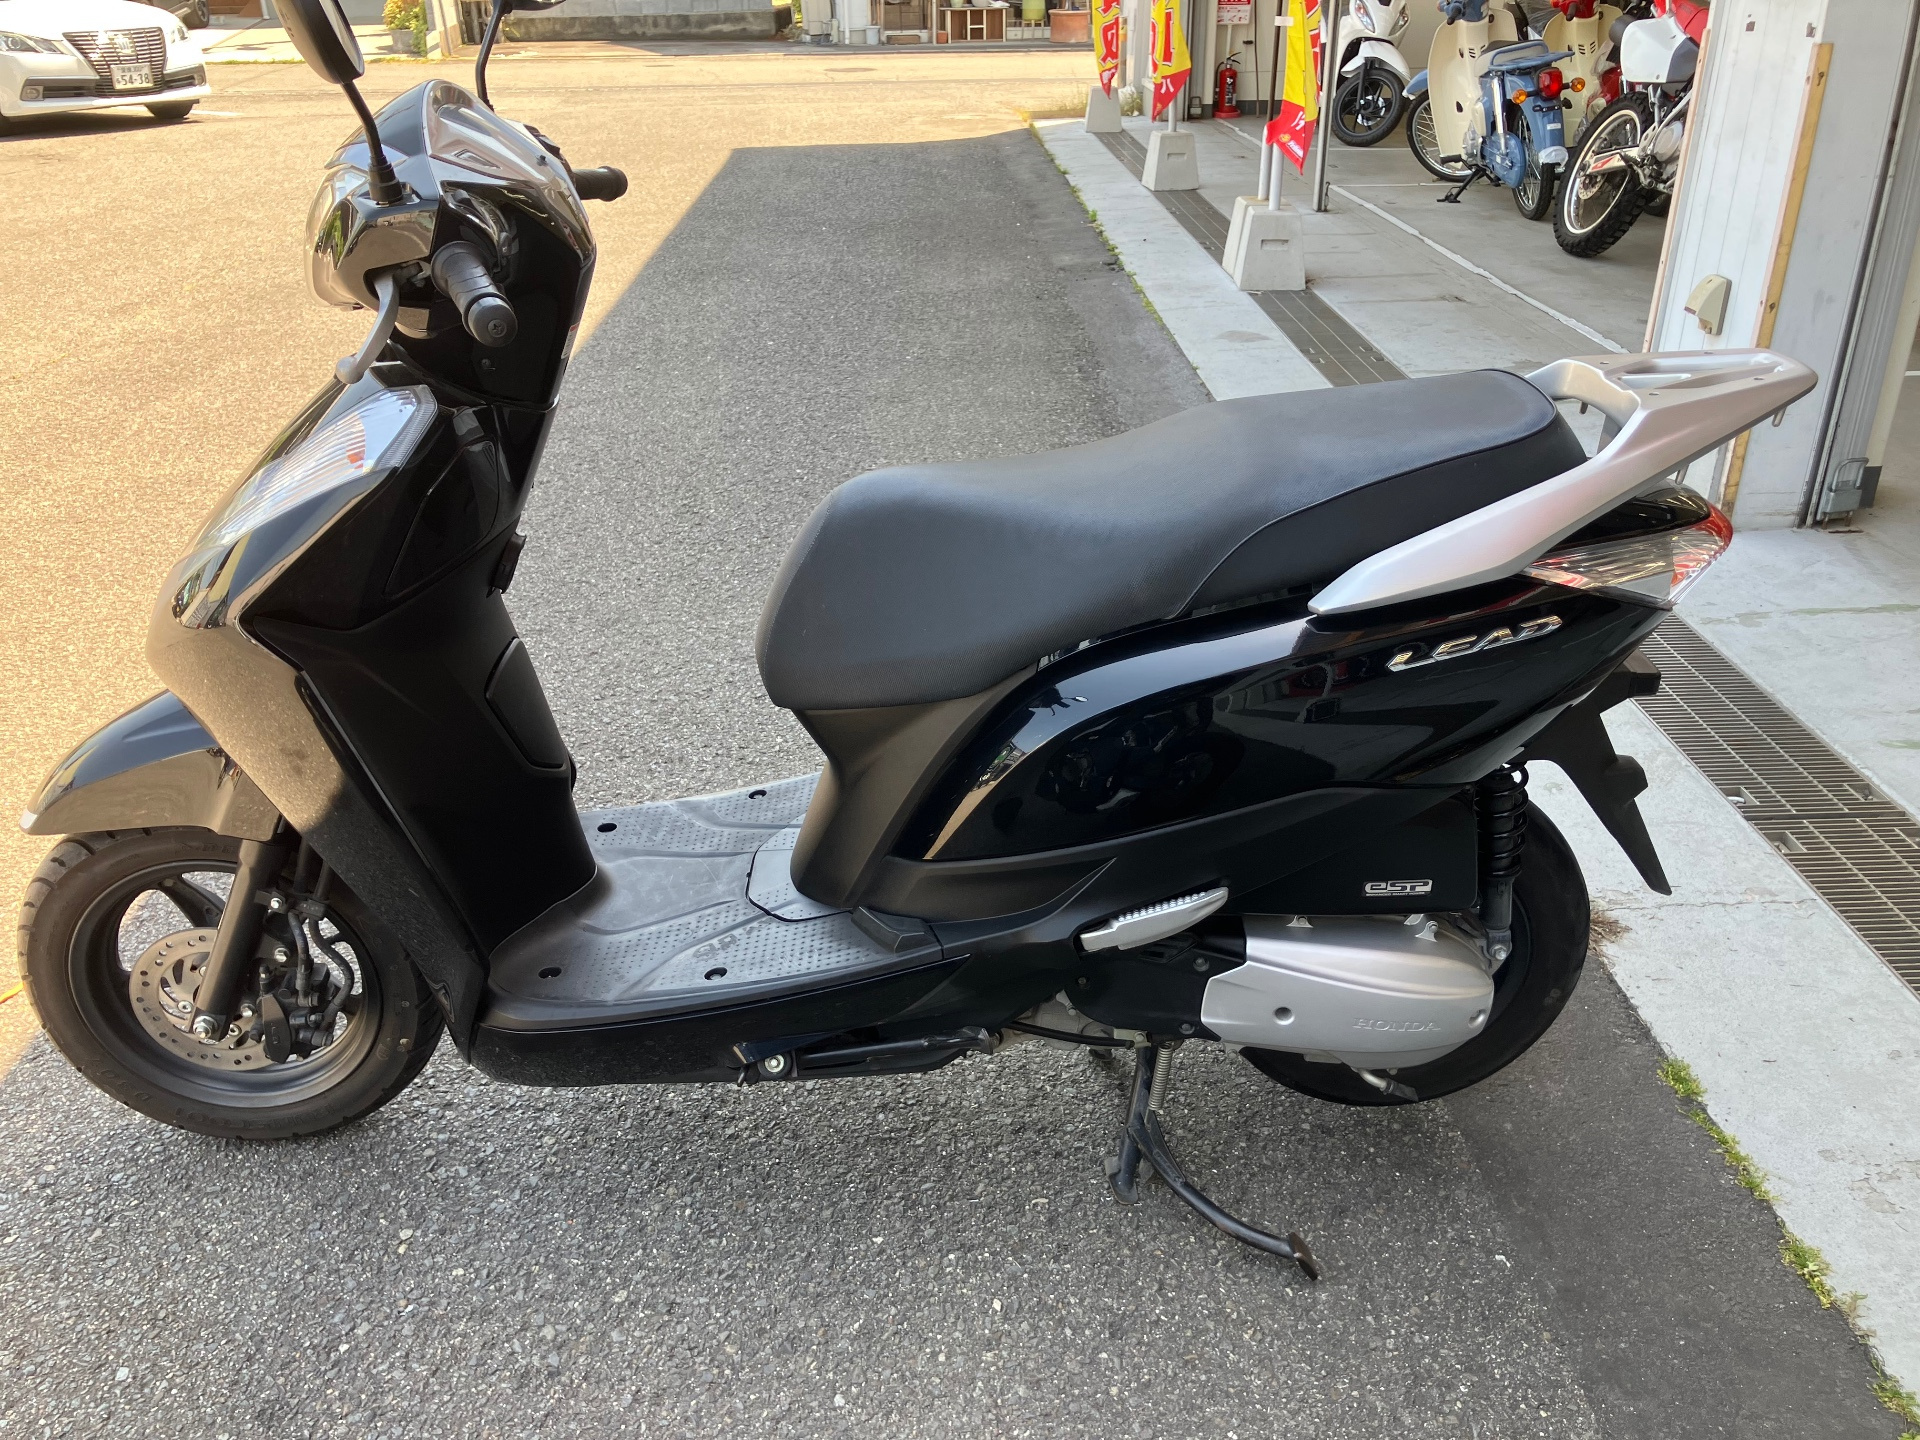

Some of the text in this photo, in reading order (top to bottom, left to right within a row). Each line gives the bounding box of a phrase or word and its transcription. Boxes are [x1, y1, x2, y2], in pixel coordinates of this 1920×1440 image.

[120, 73, 149, 85] 54-38
[1385, 615, 1563, 672] LEAD
[1352, 1018, 1441, 1032] HONDA
